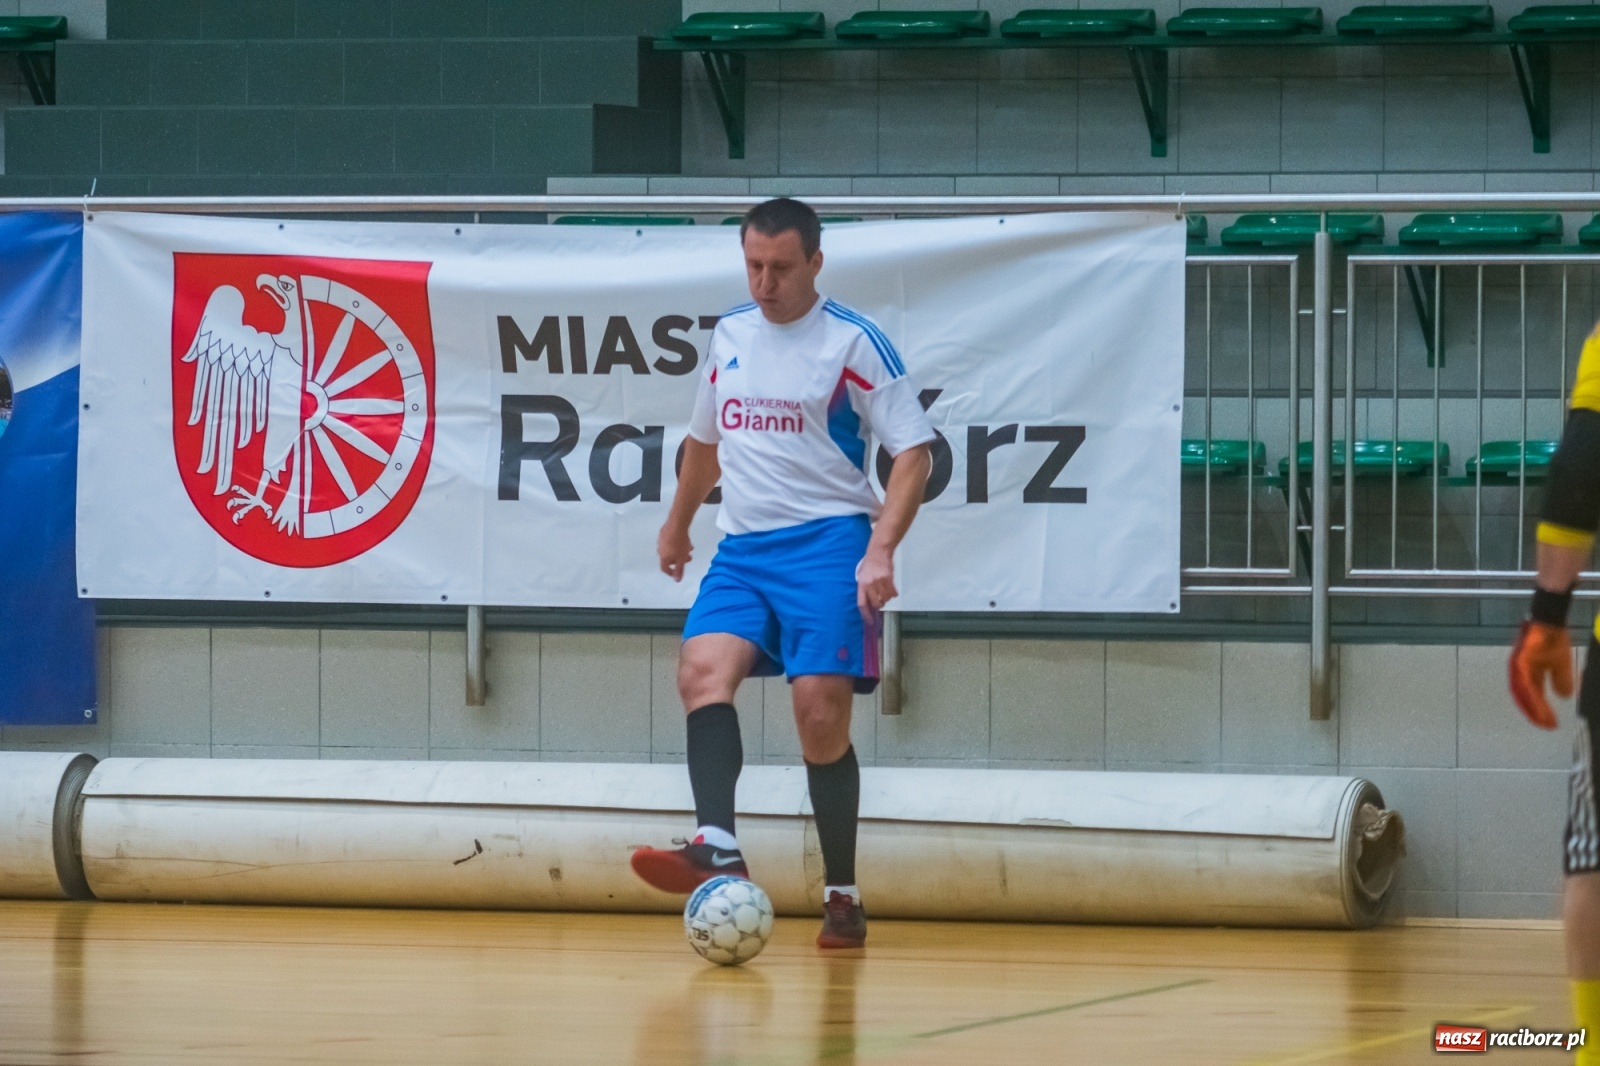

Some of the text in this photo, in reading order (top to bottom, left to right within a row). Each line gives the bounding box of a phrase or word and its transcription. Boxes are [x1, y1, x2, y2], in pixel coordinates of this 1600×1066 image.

[497, 314, 721, 376] MIAS
[721, 398, 803, 433] Gianni
[744, 397, 802, 412] CUKIERNIA
